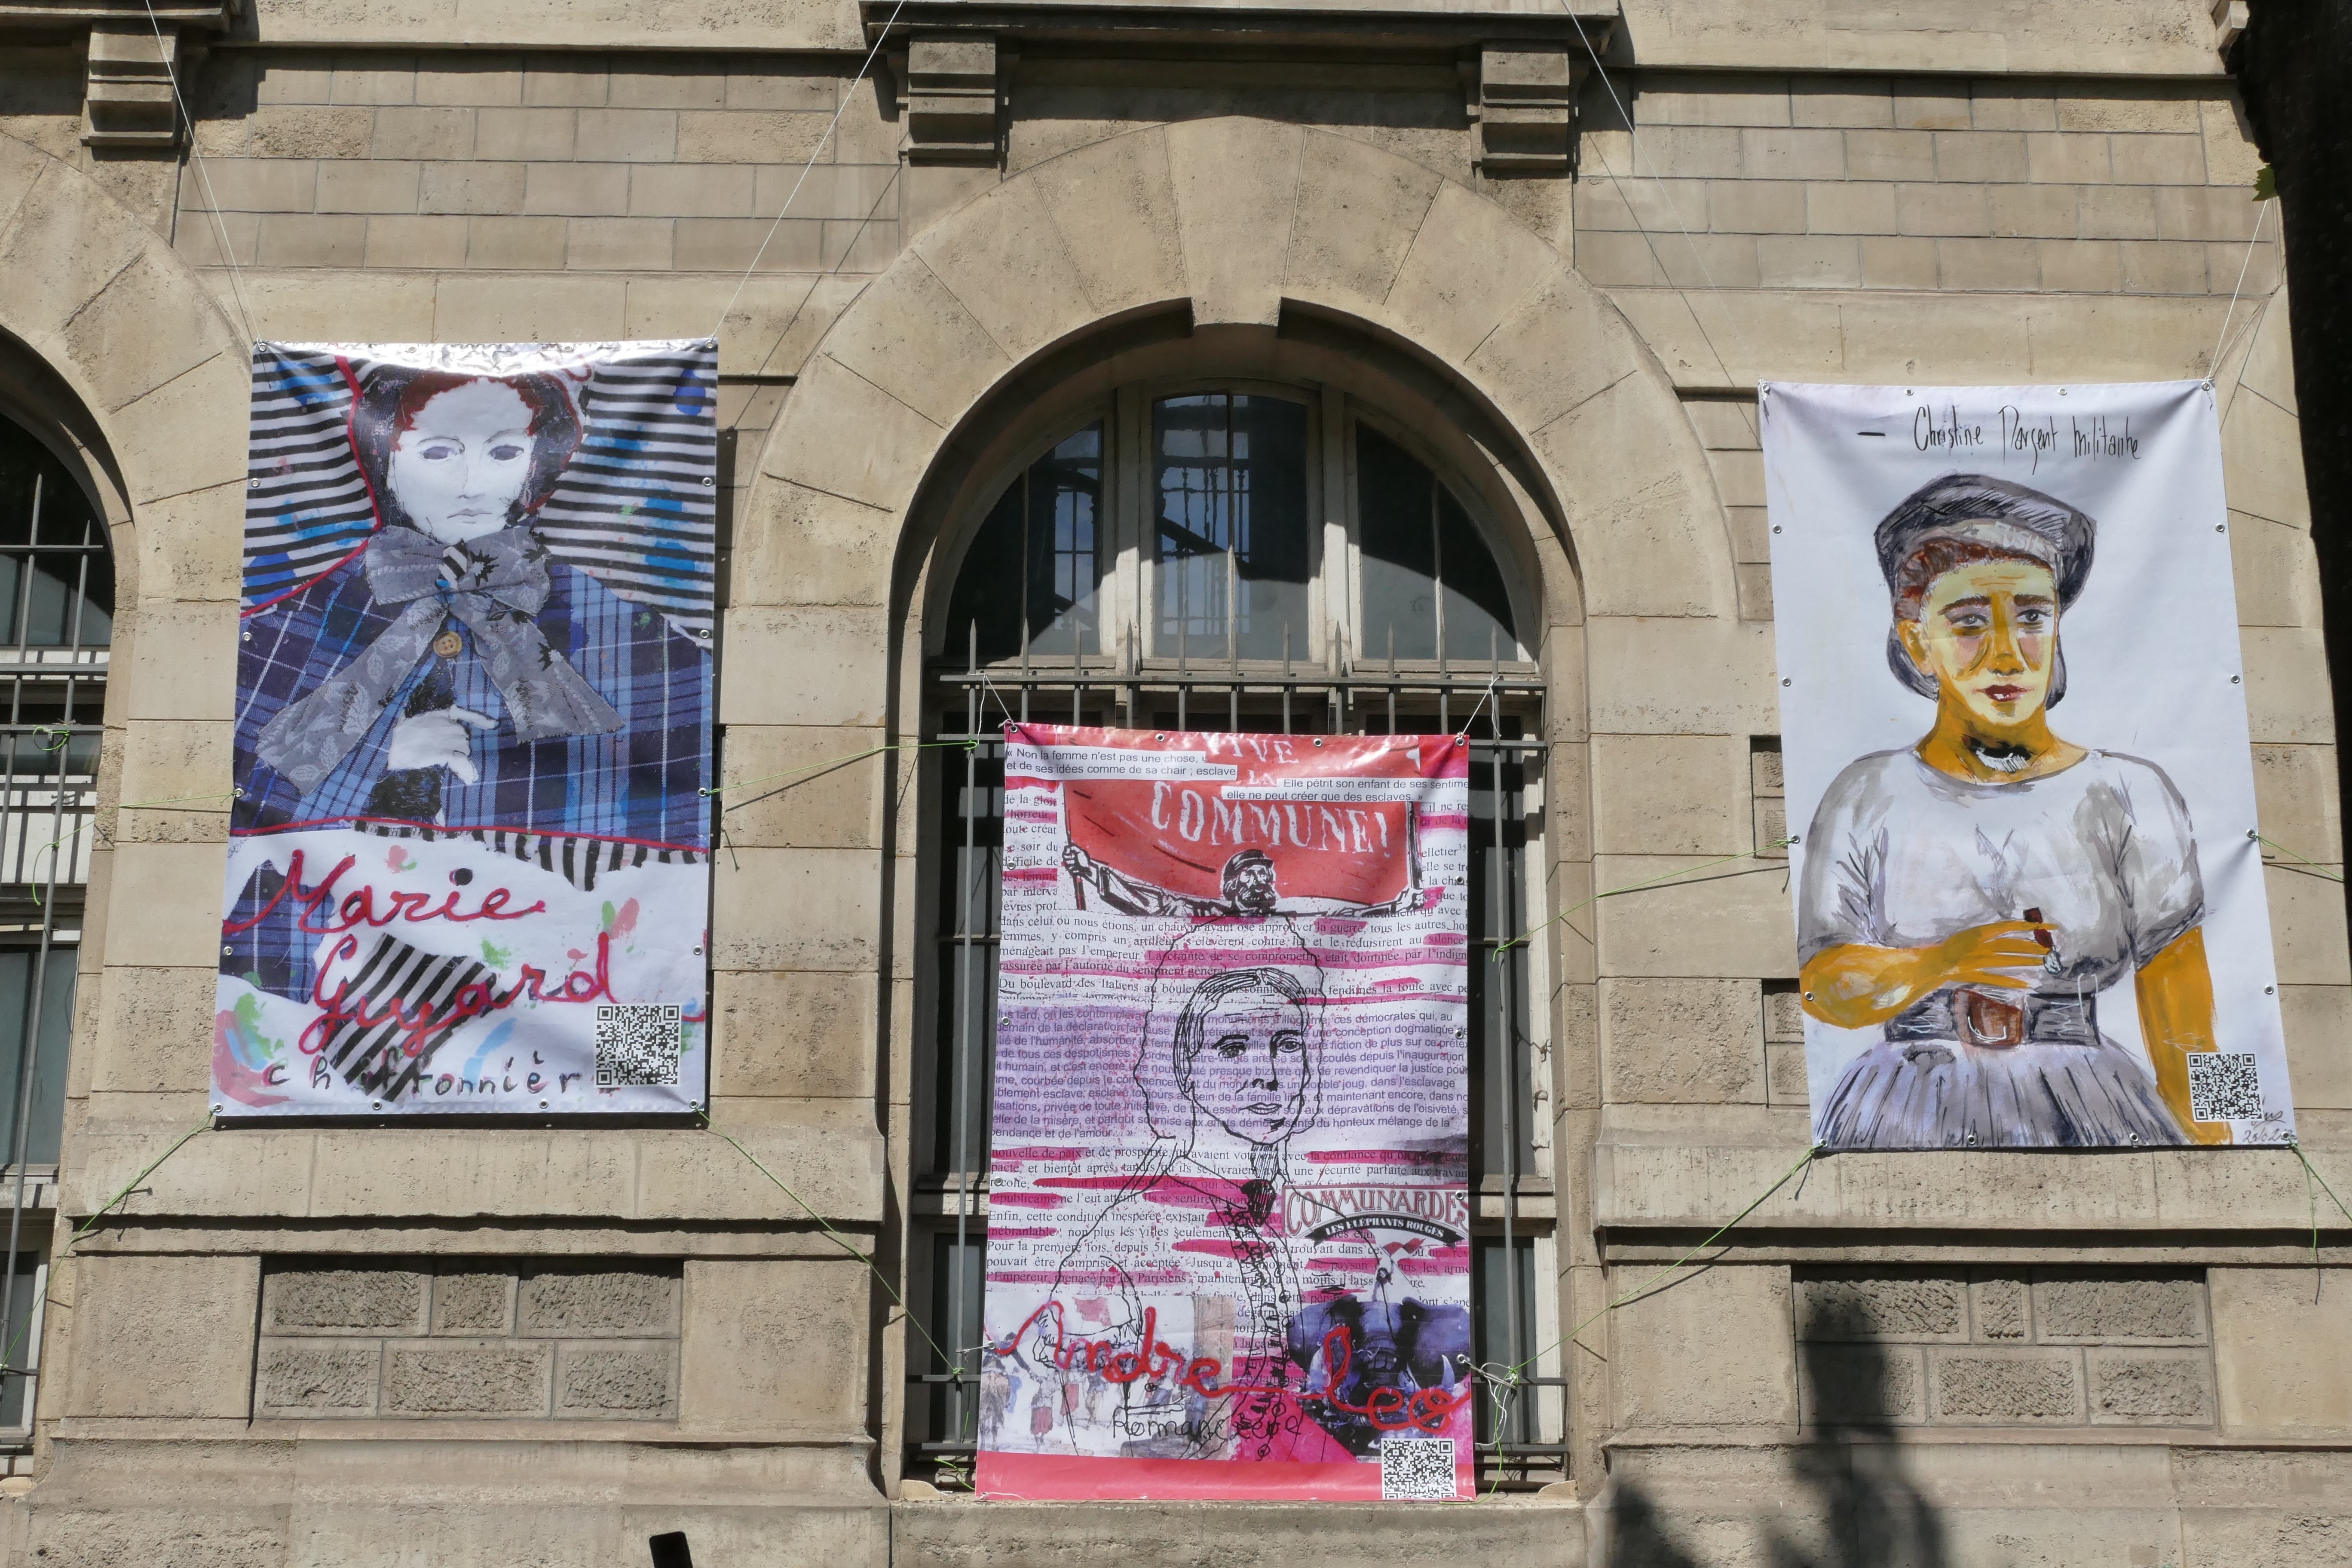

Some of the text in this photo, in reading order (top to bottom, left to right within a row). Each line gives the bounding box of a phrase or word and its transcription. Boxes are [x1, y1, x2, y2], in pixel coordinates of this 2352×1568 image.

[1914, 405, 1983, 450] Christine
[1201, 732, 1299, 763] VIVE
[1017, 748, 1037, 760] Non
[1053, 750, 1087, 760] femme
[1091, 751, 1116, 760] n'est
[1164, 755, 1198, 763] chose,
[1057, 764, 1083, 773] idées
[1130, 765, 1142, 774] de
[1161, 766, 1186, 775] chair
[1197, 766, 1235, 775] esclave
[1248, 770, 1277, 787] LA
[1307, 779, 1332, 790] pétrit
[1358, 780, 1390, 788] enfant
[1020, 794, 1028, 804] la
[1227, 791, 1245, 799] elle
[1291, 791, 1318, 800] créer
[1344, 793, 1362, 801] des
[1366, 793, 1413, 801] esclaves.
[1150, 780, 1391, 858] COMMUNE!
[1021, 843, 1041, 851] soir
[1429, 876, 1437, 885] la
[222, 848, 545, 936] Marie
[1028, 916, 1052, 926] celui
[1074, 919, 1098, 927] nous
[1317, 922, 1326, 932] la
[1331, 925, 1366, 934] guerre,
[1370, 924, 1392, 933] tous
[1397, 923, 1411, 932] les
[1052, 933, 1059, 942] y
[1065, 932, 1106, 943] compris
[1252, 937, 1285, 945] contre
[1330, 937, 1338, 946] le
[1059, 946, 1076, 955] pas
[1210, 951, 1222, 960] de
[1405, 951, 1422, 962] par
[1046, 962, 1062, 973] par
[1116, 963, 1129, 973] du
[999, 978, 1014, 988] Du
[1020, 978, 1072, 989] boulevard
[1078, 978, 1095, 988] des
[1383, 984, 1392, 992] la
[1399, 981, 1424, 992] foule
[299, 932, 619, 1054] Guyard
[1060, 1009, 1074, 1018] les
[1356, 1012, 1415, 1023] démocrates
[1419, 1011, 1437, 1022] qui,
[1038, 1023, 1050, 1032] de
[1054, 1023, 1063, 1031] la
[1335, 1026, 1391, 1037] conception
[1015, 1036, 1027, 1044] de
[1365, 1039, 1378, 1048] de
[1381, 1038, 1402, 1048] plus
[1406, 1038, 1422, 1046] sur
[1001, 1049, 1394, 1063] de tous ces depuis
[1050, 1062, 1060, 1071] et
[1090, 1061, 1125, 1070] encore
[1334, 1064, 1396, 1077] revendiquer
[1400, 1063, 1408, 1072] la
[1412, 1062, 1443, 1075] justice
[1067, 1074, 1100, 1087] depuis
[1104, 1074, 1112, 1083] le
[1371, 1076, 1396, 1086] dans
[1089, 1088, 1128, 1097] esclave
[1326, 1091, 1385, 1102] maintenant
[1388, 1091, 1426, 1100] encore,
[1430, 1091, 1453, 1101] dans
[1079, 1102, 1091, 1111] de
[1095, 1101, 1120, 1111] toute
[1398, 1103, 1410, 1113] de
[1014, 1115, 1449, 1128] de la et du honteux mélange de la
[1045, 1128, 1071, 1138] et de
[1042, 1148, 1054, 1157] de
[1086, 1148, 1095, 1157] et
[1367, 1165, 1406, 1176] parfaite
[989, 1209, 1107, 1222] Enfin, cette condition
[1094, 1226, 1134, 1239] plus les
[1325, 1225, 1344, 1236] LES
[1407, 1221, 1444, 1237] ROUGES
[988, 1241, 1363, 1253] Pour la depuis dans
[987, 1257, 1055, 1268] pouvait être
